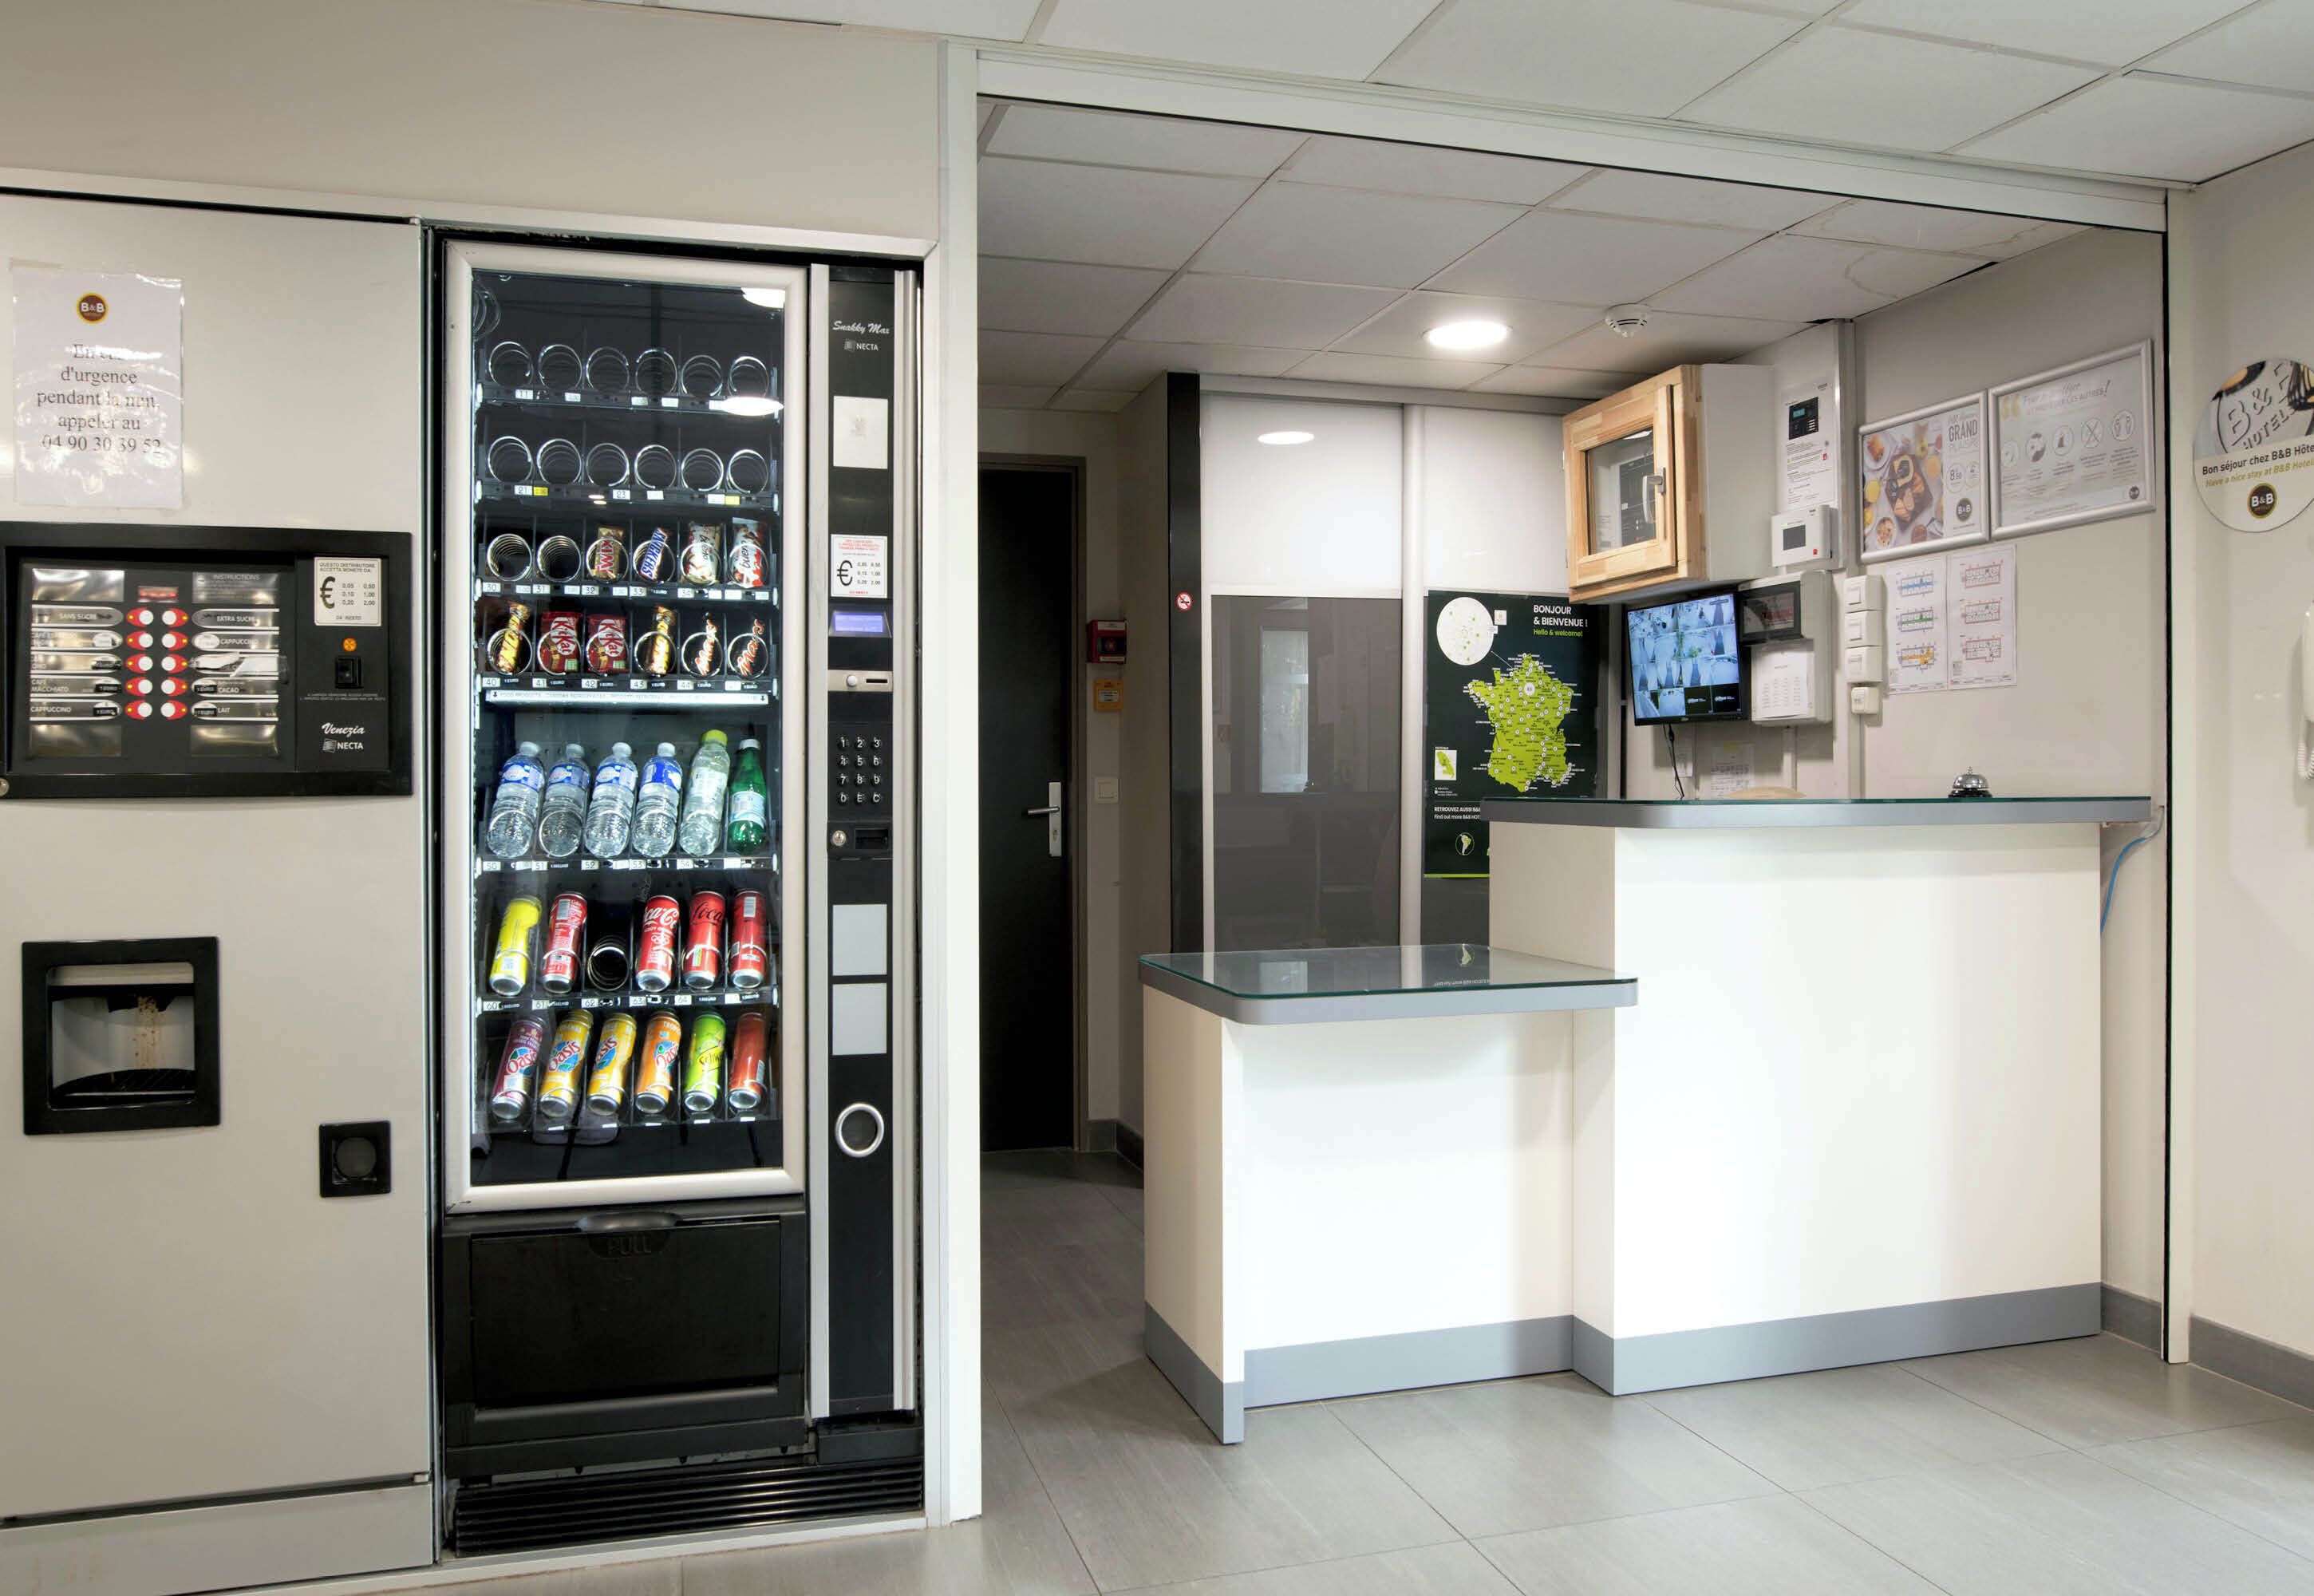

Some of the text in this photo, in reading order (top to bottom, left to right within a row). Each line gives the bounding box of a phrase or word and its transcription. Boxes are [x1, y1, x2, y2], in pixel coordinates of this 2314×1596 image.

[81, 302, 105, 313] B&B
[61, 366, 137, 386] d'urgence
[37, 389, 101, 407] pendant
[122, 418, 141, 429] au
[1949, 420, 1977, 442] GRAND
[42, 435, 61, 449] 04
[68, 436, 87, 451] 90
[93, 437, 112, 451] 30
[2202, 465, 2218, 475] Bon
[2221, 460, 2247, 472] séjour
[2249, 455, 2269, 464] chez
[2272, 448, 2292, 460] B&B
[2251, 493, 2274, 508] B&B
[836, 559, 853, 587] €
[320, 576, 336, 609] €
[1534, 604, 1572, 614] BONJOUR
[1534, 616, 1540, 625] &
[1542, 617, 1584, 627] BIENVENUE
[322, 722, 365, 737] Venezia
[548, 1040, 582, 1072] Oasis
